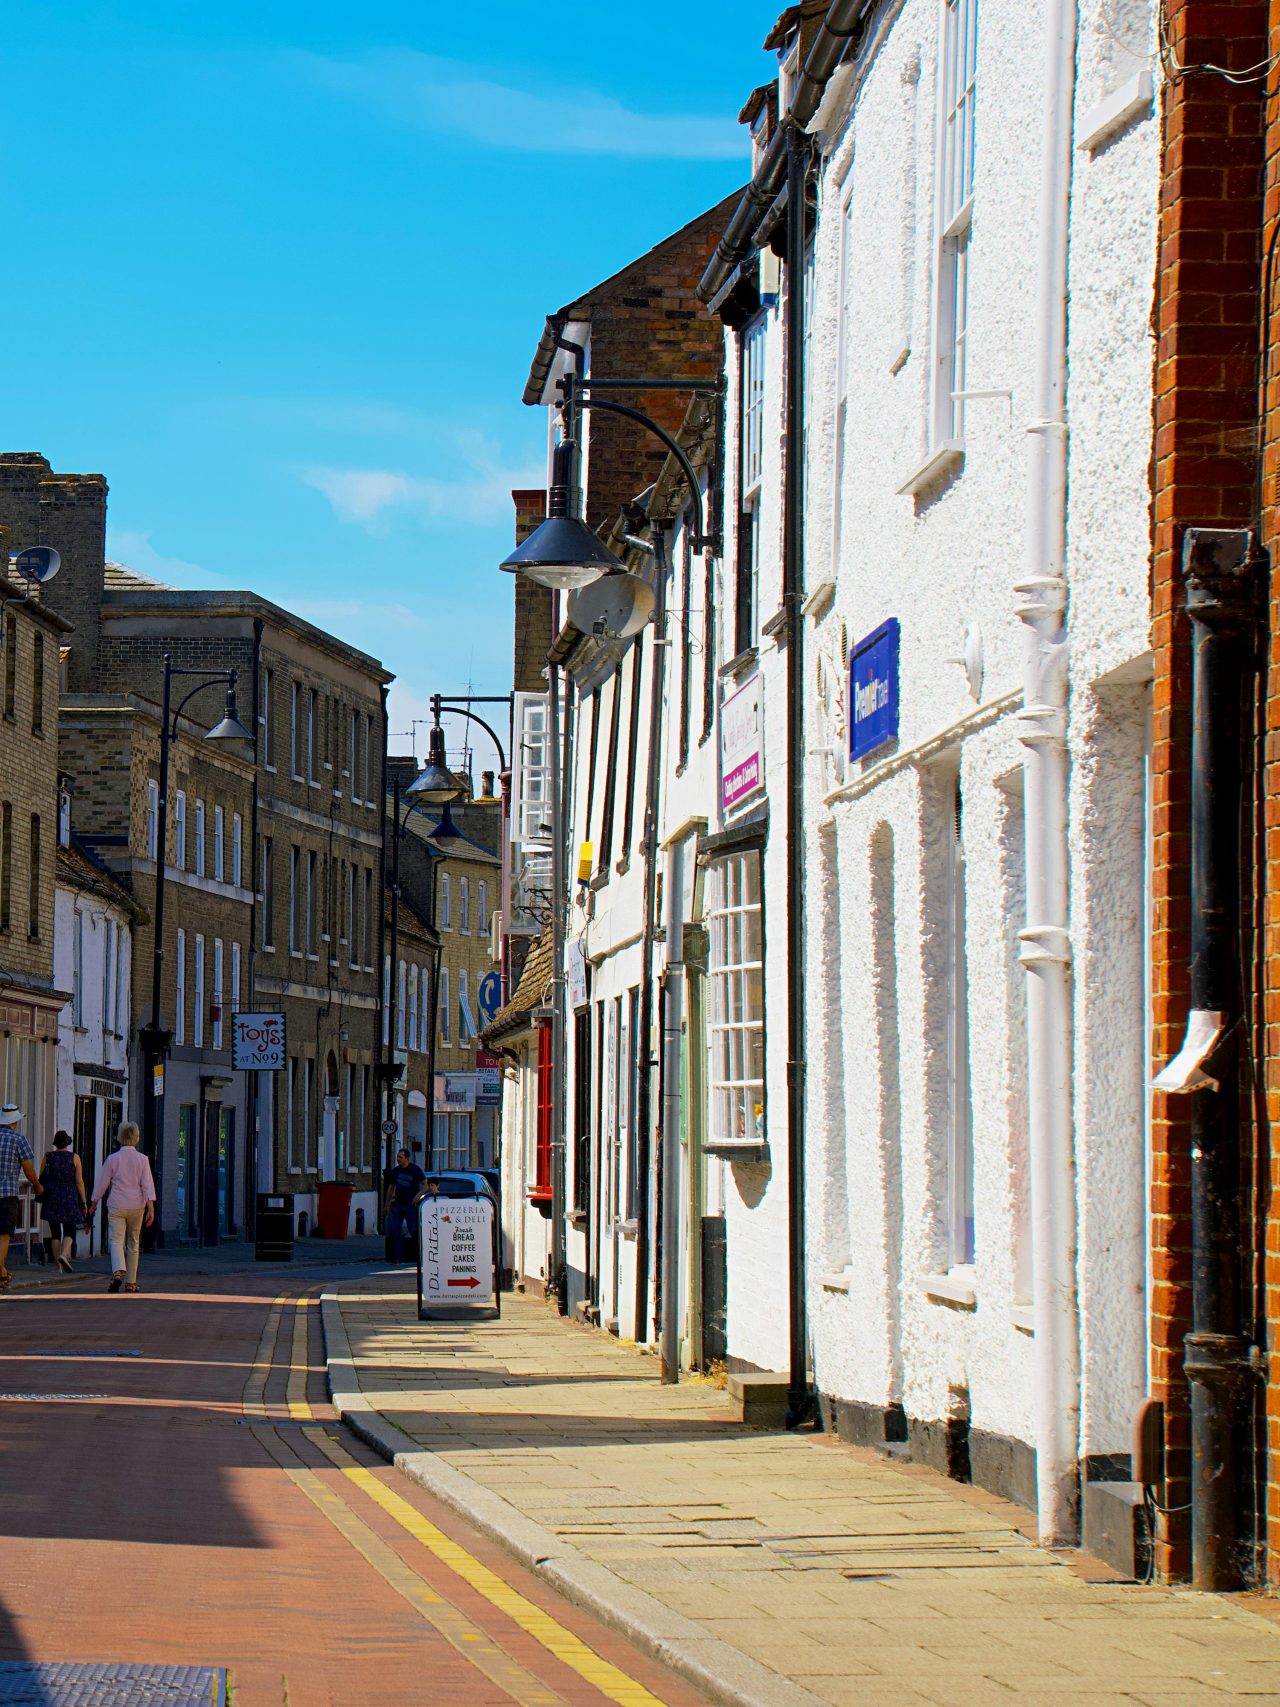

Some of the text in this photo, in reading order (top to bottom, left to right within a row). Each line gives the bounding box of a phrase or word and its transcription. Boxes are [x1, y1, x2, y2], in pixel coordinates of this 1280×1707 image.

[384, 1123, 395, 1131] 20
[440, 1206, 485, 1214] PIZZERIA
[455, 1215, 486, 1223] & DELI
[454, 1226, 473, 1234] Fresh
[452, 1233, 475, 1242] BREAD
[451, 1244, 476, 1252] COFFEE
[453, 1254, 475, 1263] CAKES
[451, 1265, 477, 1273] PANINIS
